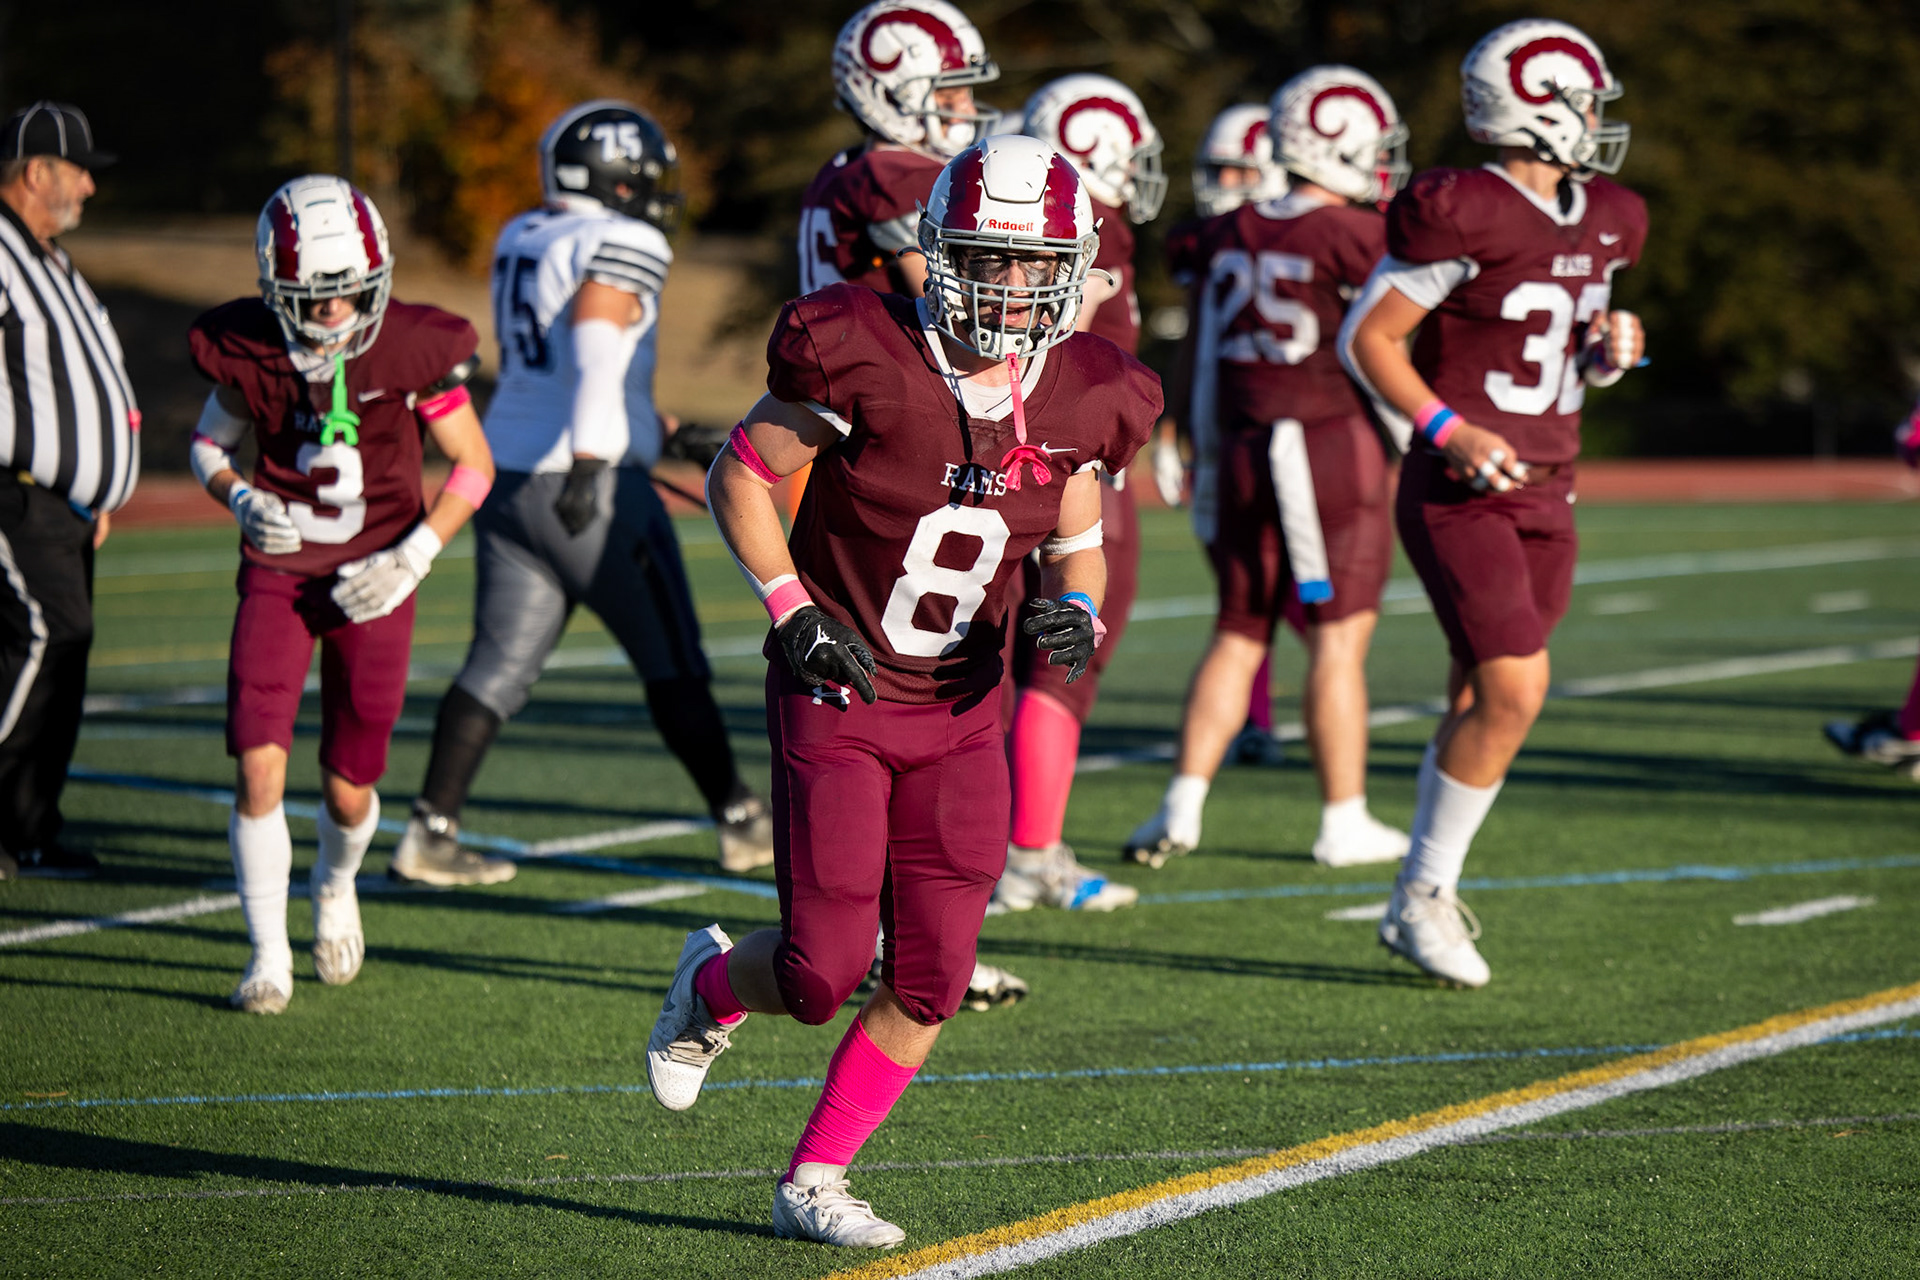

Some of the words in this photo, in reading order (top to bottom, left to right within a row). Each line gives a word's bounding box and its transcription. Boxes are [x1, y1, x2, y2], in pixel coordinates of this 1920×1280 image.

[592, 122, 643, 162] 75
[1210, 250, 1319, 365] 25
[289, 440, 366, 544] 3
[940, 462, 1007, 496] RAMS
[881, 505, 1010, 657] 8
